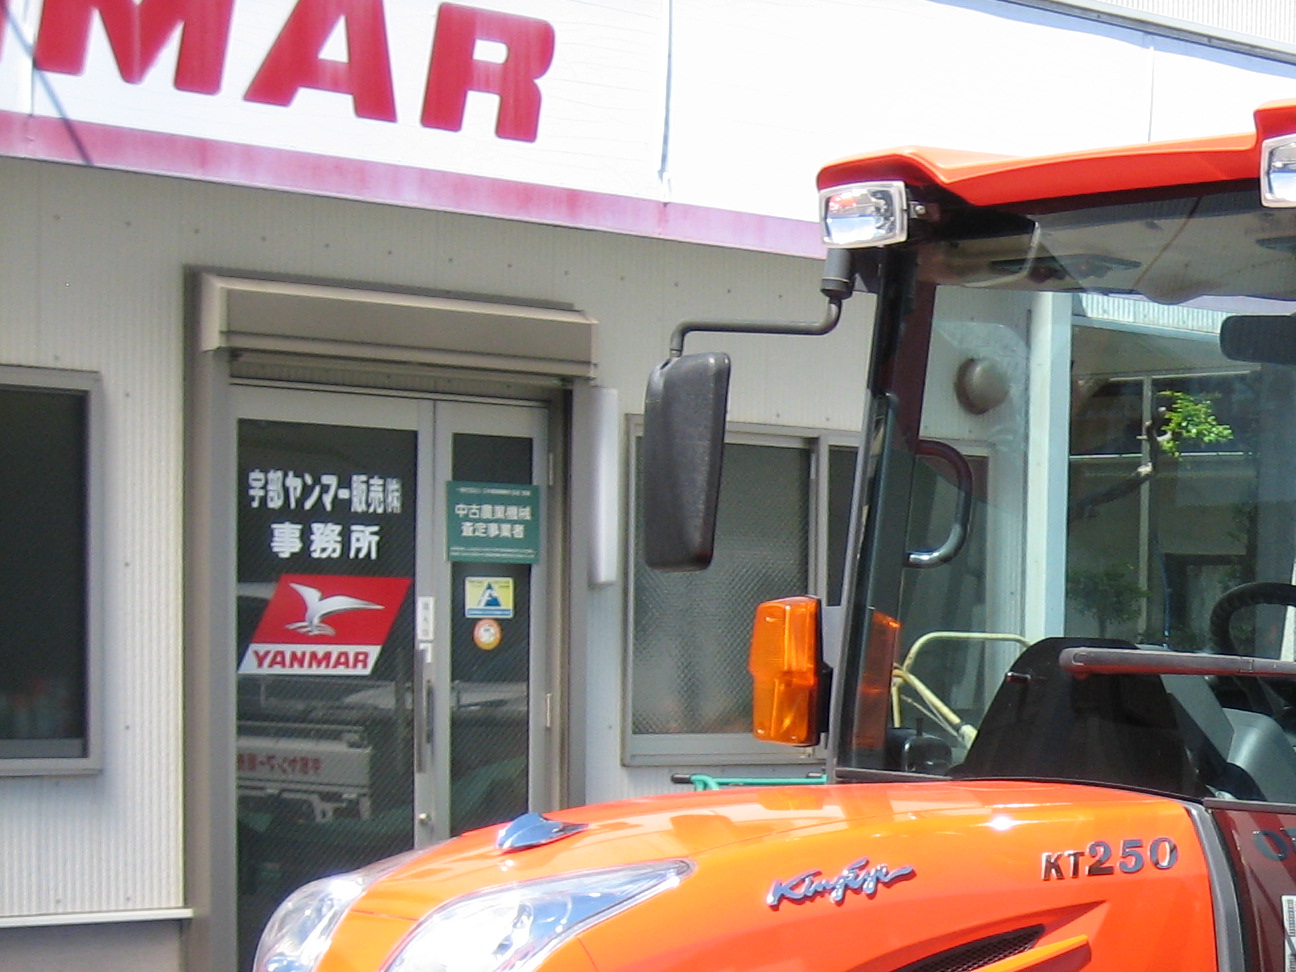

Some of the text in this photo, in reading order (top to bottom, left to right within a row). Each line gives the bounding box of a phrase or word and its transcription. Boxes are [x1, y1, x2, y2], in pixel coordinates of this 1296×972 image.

[0, 0, 556, 143] MAR
[270, 521, 380, 560] 事務所
[252, 649, 369, 670] YANMAR
[1041, 837, 1179, 881] KT250
